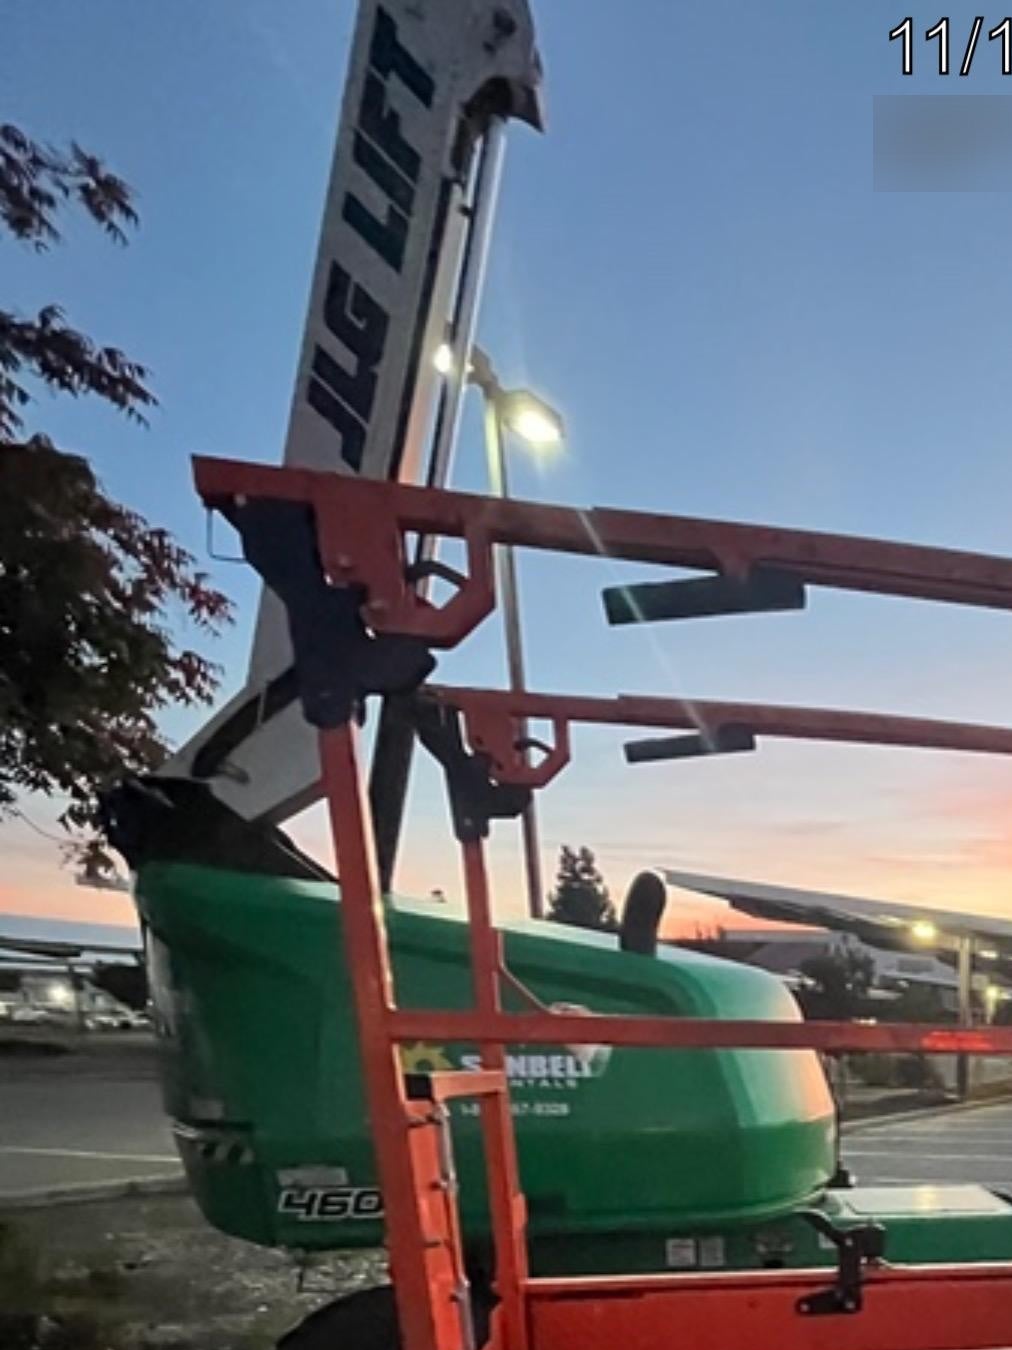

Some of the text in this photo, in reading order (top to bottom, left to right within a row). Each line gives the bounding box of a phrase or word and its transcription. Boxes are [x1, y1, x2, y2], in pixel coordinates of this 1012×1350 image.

[307, 4, 435, 473] JLG LIFT
[460, 1054, 592, 1078] SNBELT
